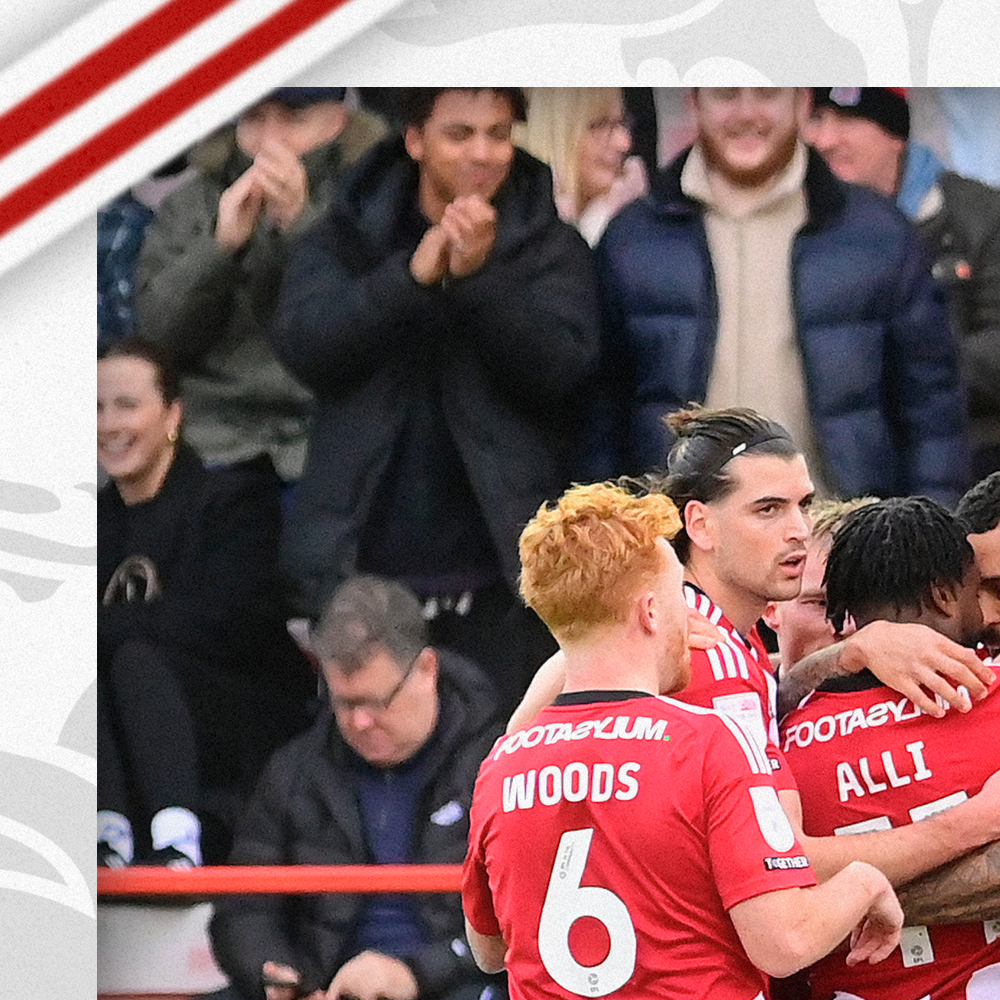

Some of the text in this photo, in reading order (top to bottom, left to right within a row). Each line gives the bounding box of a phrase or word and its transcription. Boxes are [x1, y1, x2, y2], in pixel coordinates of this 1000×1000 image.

[502, 762, 641, 813] WOODS
[836, 741, 933, 803] ALLI
[538, 827, 637, 998] 6
